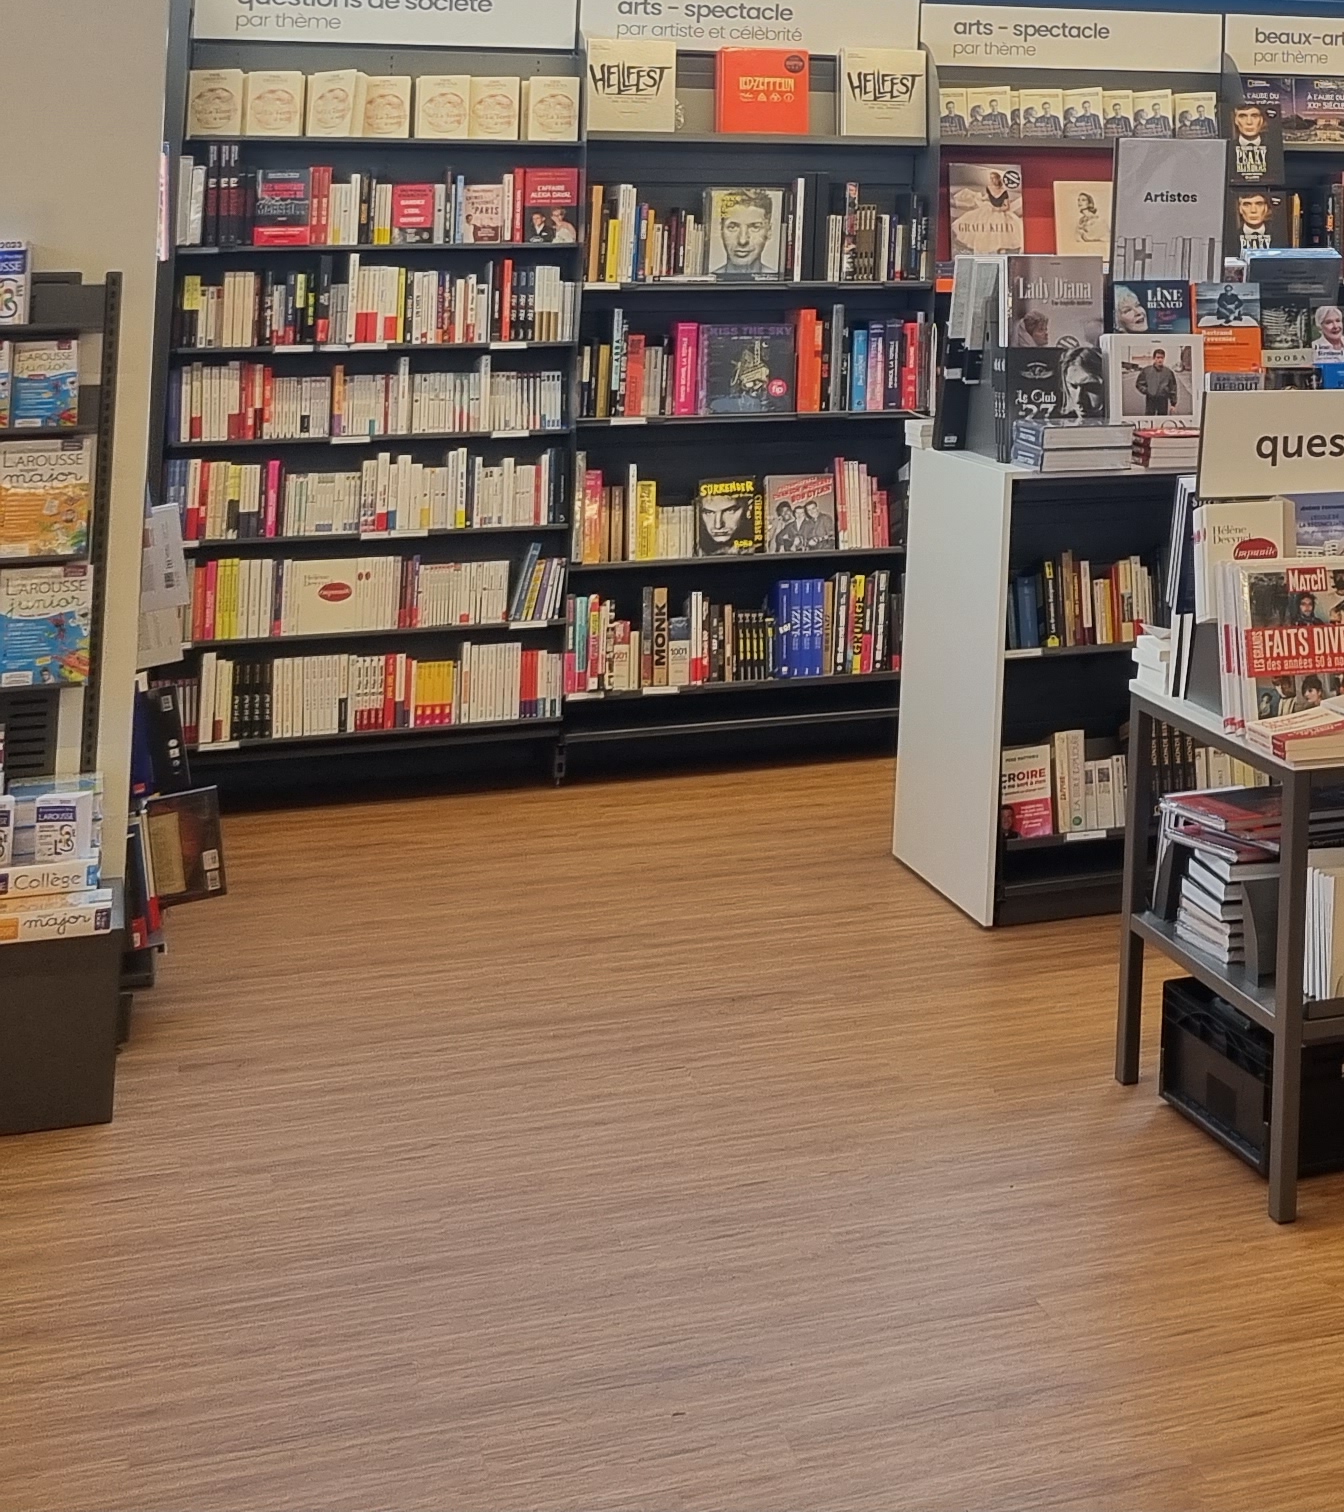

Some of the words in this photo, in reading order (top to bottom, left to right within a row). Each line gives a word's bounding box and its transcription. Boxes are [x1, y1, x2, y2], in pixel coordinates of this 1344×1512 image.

[235, 14, 272, 32] par
[275, 11, 342, 30] thème
[618, 0, 662, 17] arts
[684, 1, 794, 23] spectacle
[616, 22, 647, 39] par
[651, 22, 705, 39] artiste
[708, 24, 726, 39] et
[729, 23, 803, 43] célèbrité
[953, 20, 994, 37] arts
[1013, 21, 1111, 43] spectacle
[953, 43, 980, 58] par
[984, 41, 1037, 57] thème
[1254, 52, 1278, 66] par
[1281, 50, 1329, 65] thème
[589, 60, 673, 98] HELLFEST
[847, 68, 924, 104] HELLFEST
[1143, 190, 1198, 203] Artistes
[1016, 276, 1051, 303] Lady
[1053, 277, 1093, 300] Diana
[3, 450, 84, 468] LAROUSSE
[1212, 524, 1247, 535] Hélène
[1288, 568, 1327, 592] MATCH
[654, 602, 668, 669] MONK
[1264, 627, 1310, 657] FAITS
[1266, 657, 1282, 671] des
[1284, 655, 1314, 669] années
[1315, 655, 1326, 667] 50
[1326, 655, 1333, 666] à
[14, 872, 82, 890] Collège
